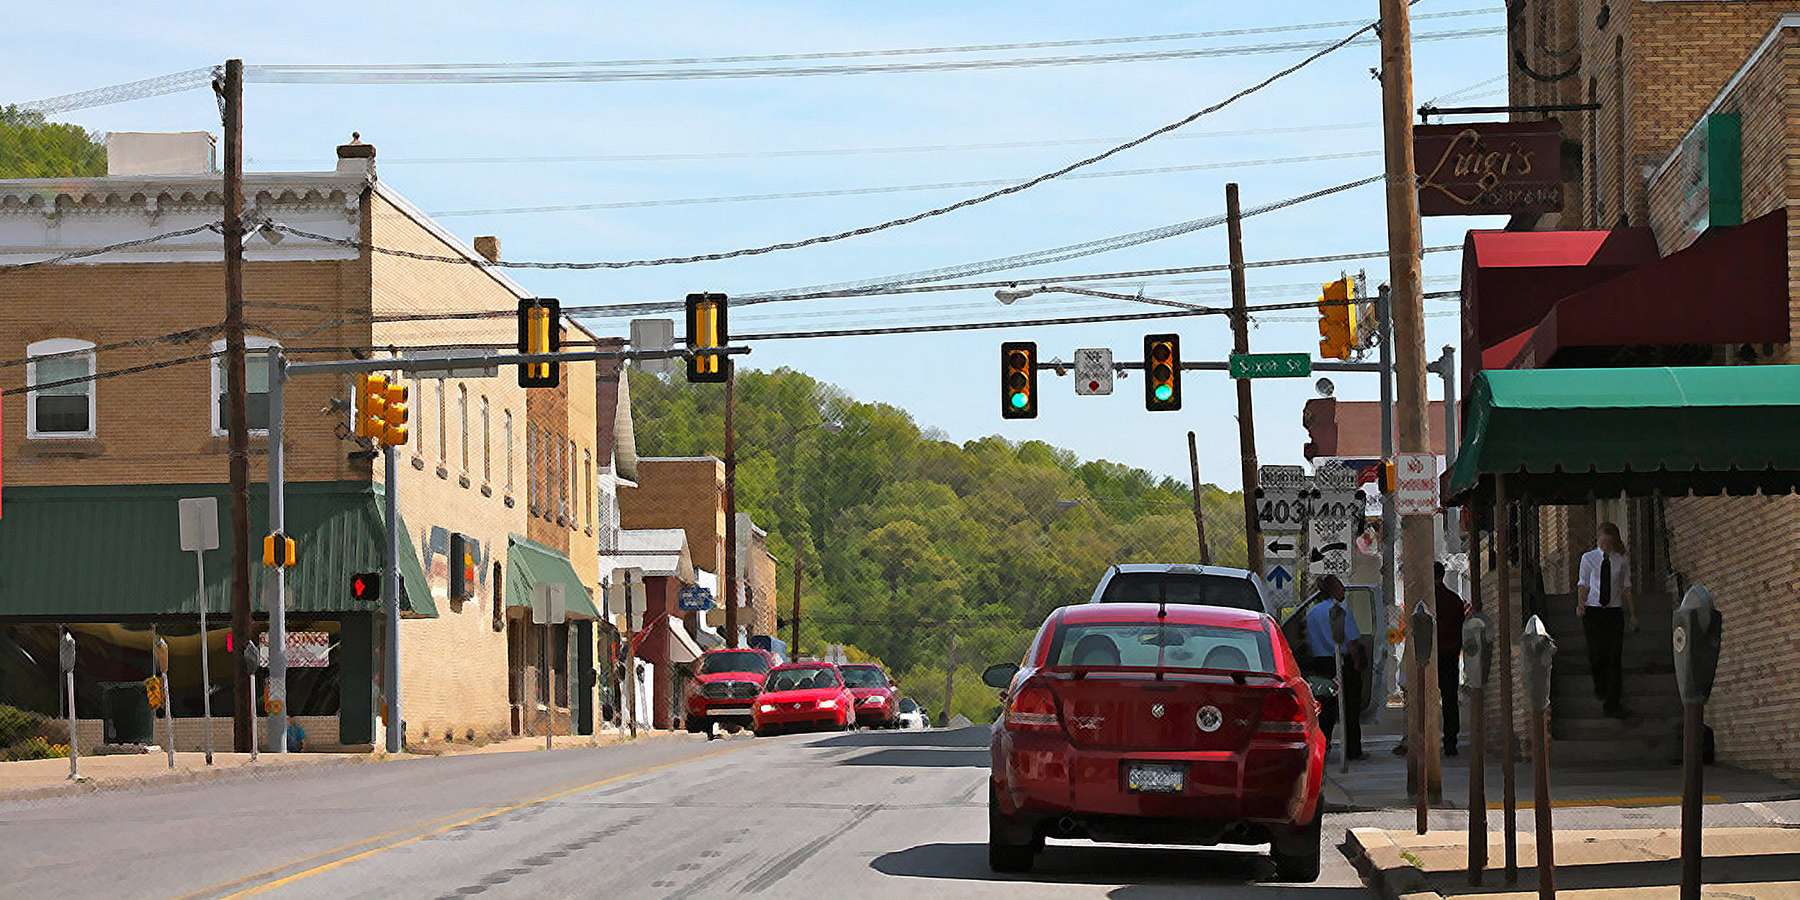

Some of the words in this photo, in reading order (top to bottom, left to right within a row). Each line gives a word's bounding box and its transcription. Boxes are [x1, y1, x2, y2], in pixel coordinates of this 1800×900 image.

[1421, 129, 1535, 206] Luigi's
[1259, 499, 1306, 524] 403
[1315, 501, 1360, 520] 403
